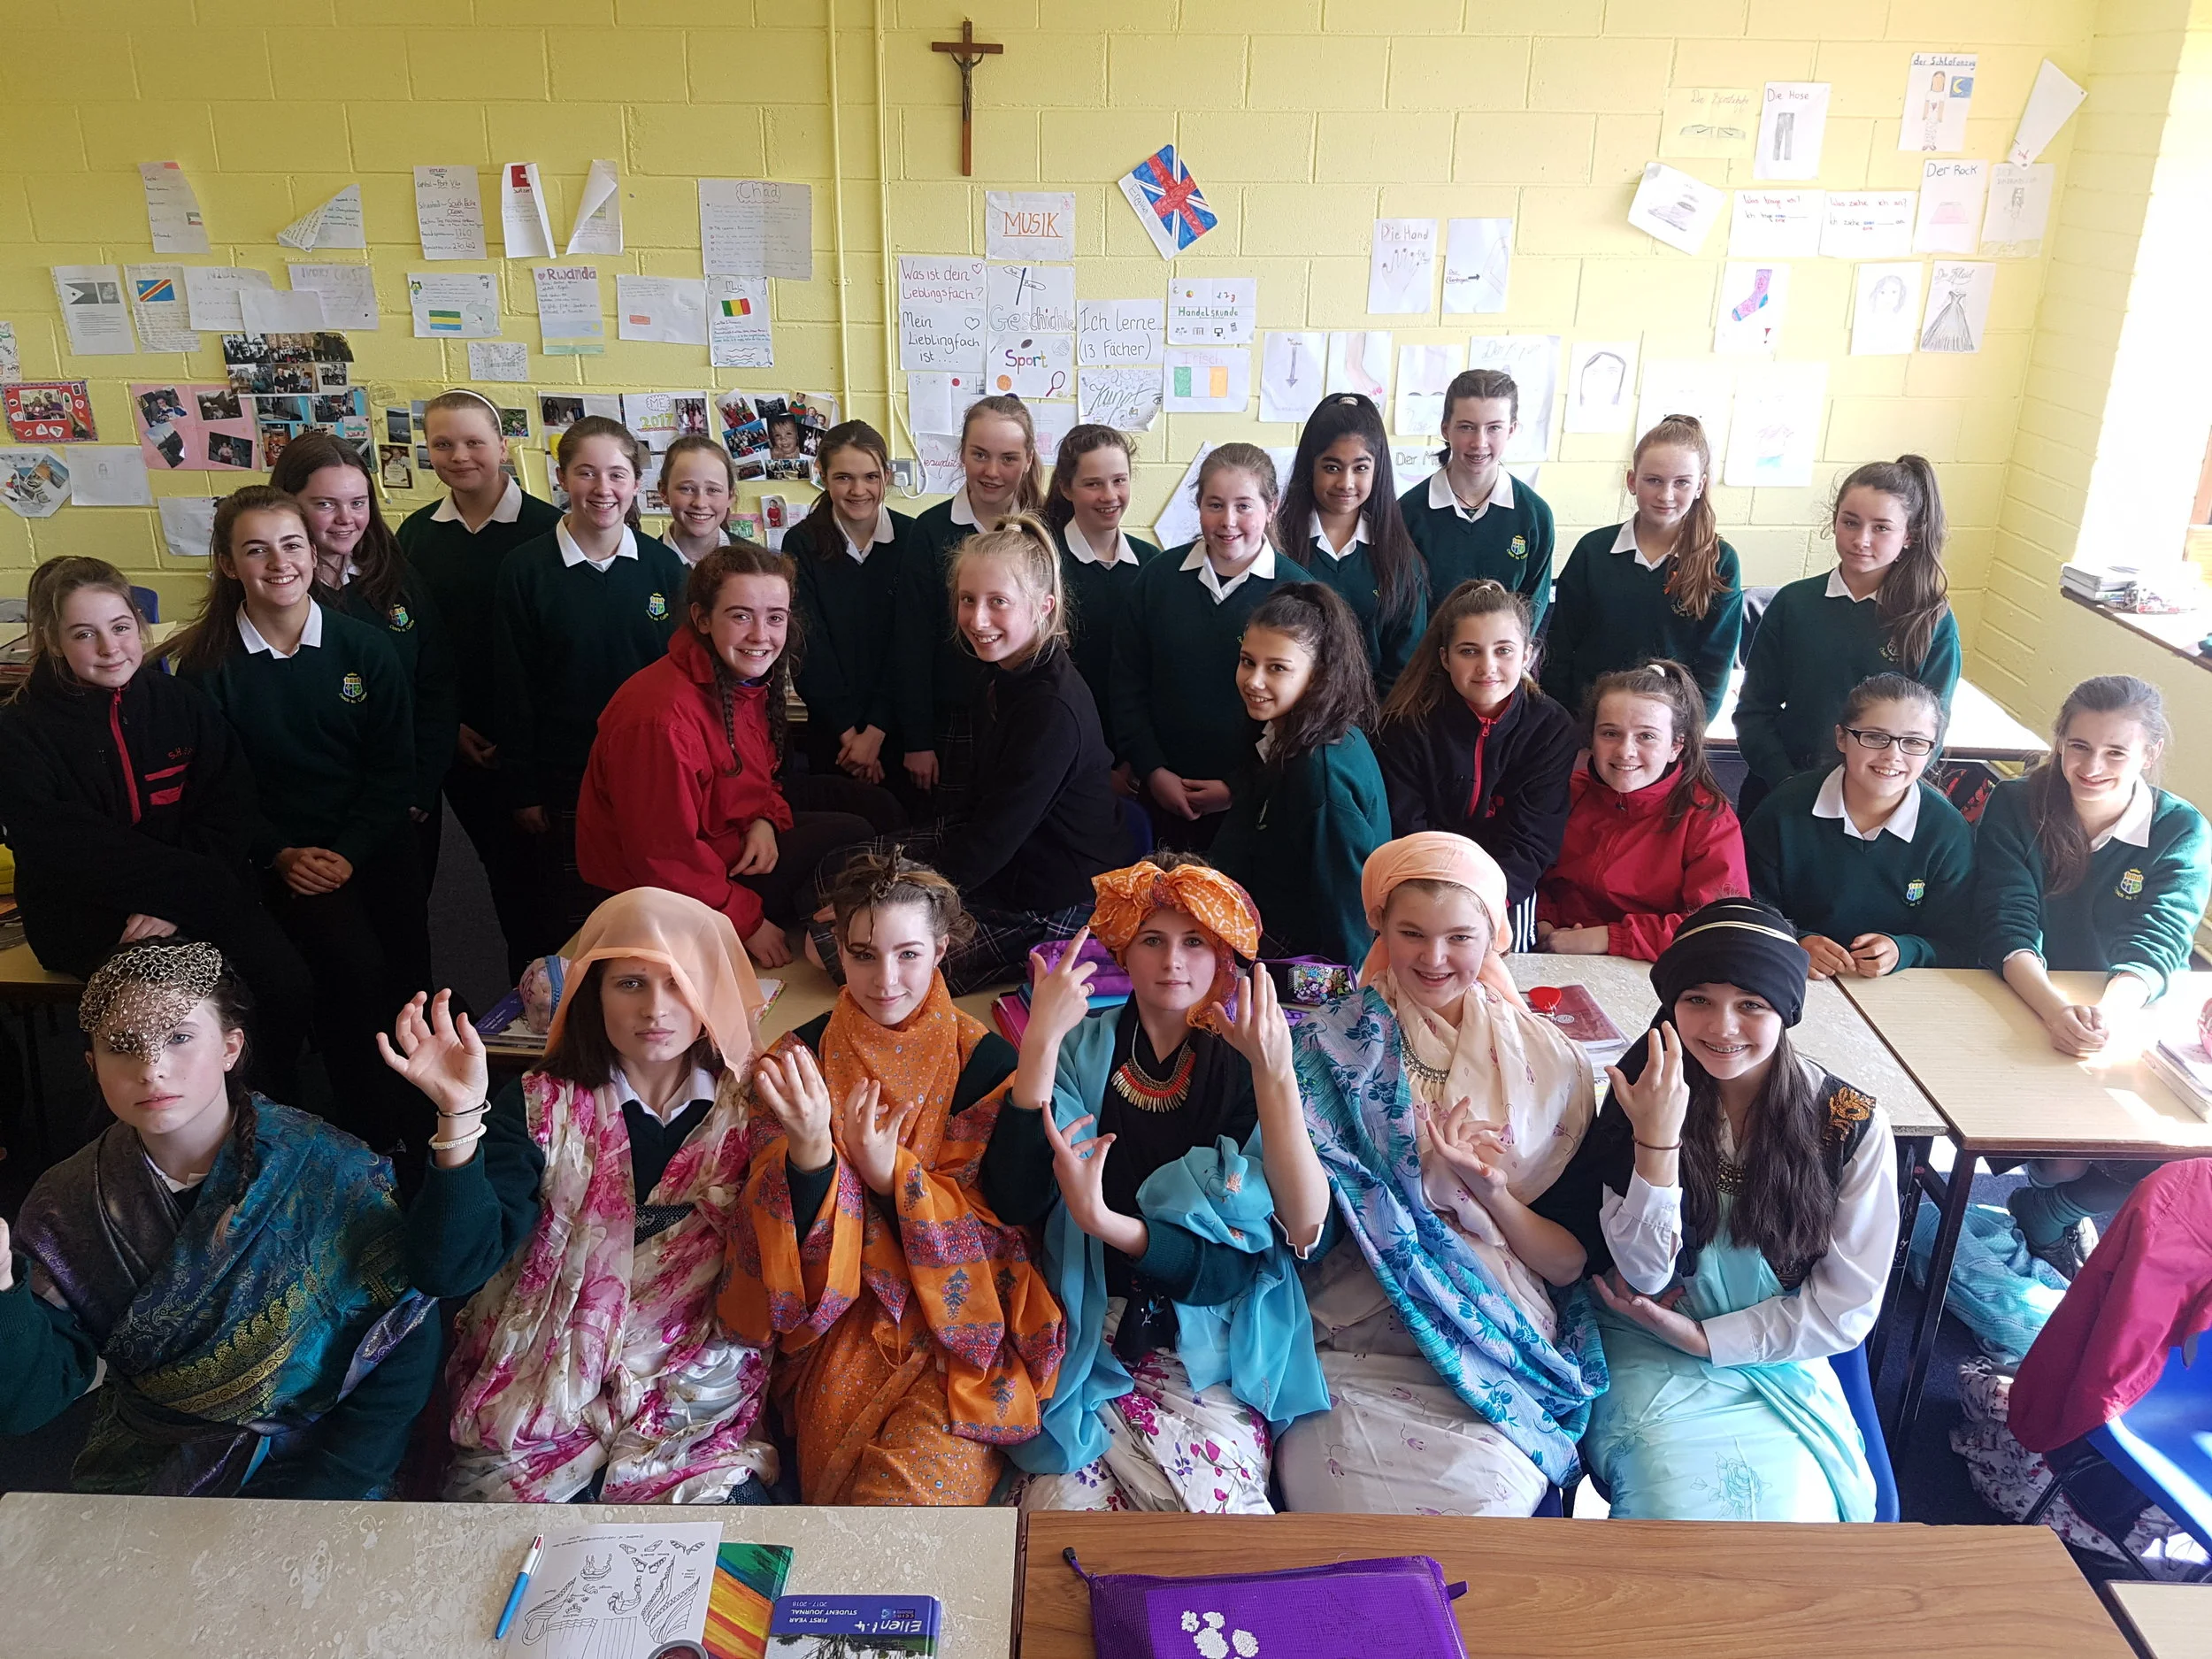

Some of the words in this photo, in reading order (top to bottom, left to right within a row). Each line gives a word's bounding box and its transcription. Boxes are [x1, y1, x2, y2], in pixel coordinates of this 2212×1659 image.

[1914, 56, 1927, 66] der
[1767, 88, 1783, 102] Die
[1789, 90, 1809, 100] Hose
[1927, 163, 1949, 177] Der
[1954, 165, 1978, 176] Rock
[739, 181, 779, 199] Chad
[1003, 211, 1060, 237] MUSIK
[1381, 223, 1401, 241] Die
[1403, 224, 1430, 241] Hand
[300, 267, 329, 279] IVORY
[546, 266, 597, 280] Rwanda
[901, 258, 925, 280] Was
[927, 268, 941, 280] ist
[943, 265, 971, 281] dein
[902, 282, 984, 303] Lieblingsfach?
[902, 311, 933, 329] Mein
[989, 304, 1075, 332] Geschichte
[1079, 306, 1110, 334] Ich
[908, 331, 980, 355] Lieblingfach
[919, 349, 935, 363] ist
[1004, 349, 1048, 374] Sport
[1181, 351, 1224, 365] Irisch
[649, 398, 665, 409] ME
[639, 412, 675, 428] 2017
[1395, 451, 1417, 466] Der
[879, 1620, 922, 1632] Ellen
